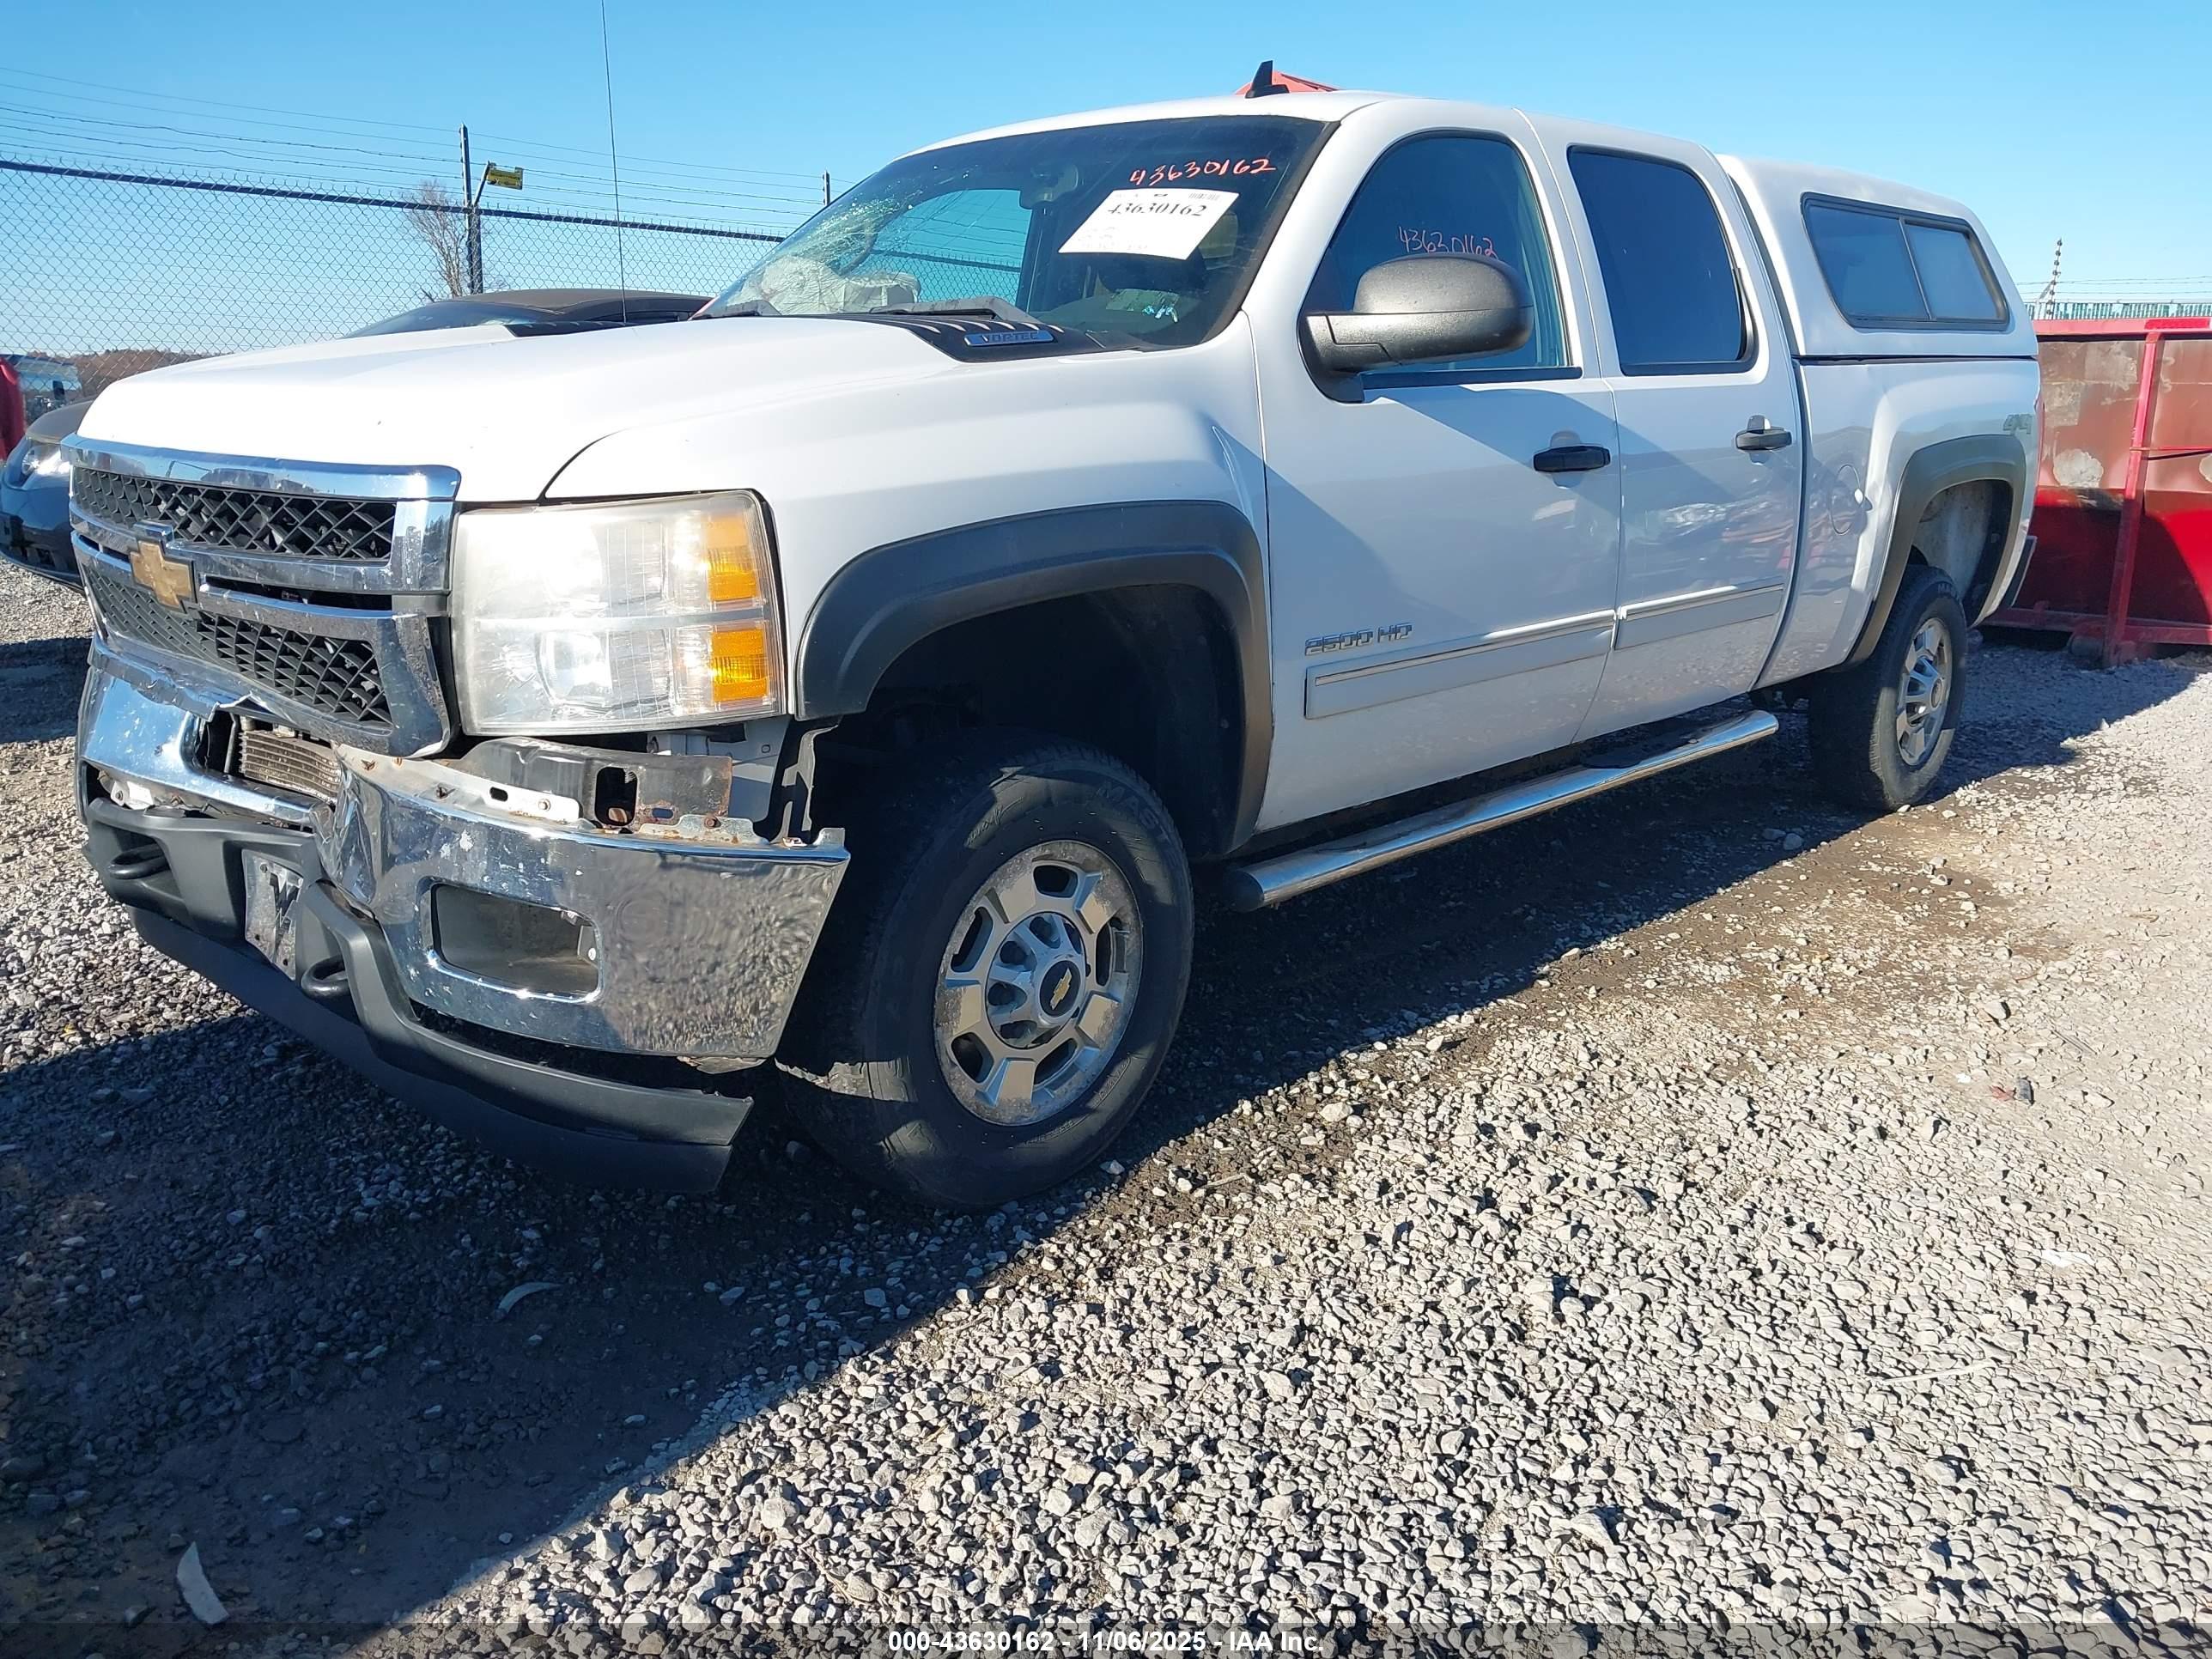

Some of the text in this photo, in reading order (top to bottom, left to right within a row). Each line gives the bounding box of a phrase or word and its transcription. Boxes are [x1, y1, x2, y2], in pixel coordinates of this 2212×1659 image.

[1129, 158, 1276, 186] 43630162
[1109, 202, 1206, 216] 43630162
[1398, 226, 1498, 259] 43630162
[1304, 622, 1413, 657] 2500 HD
